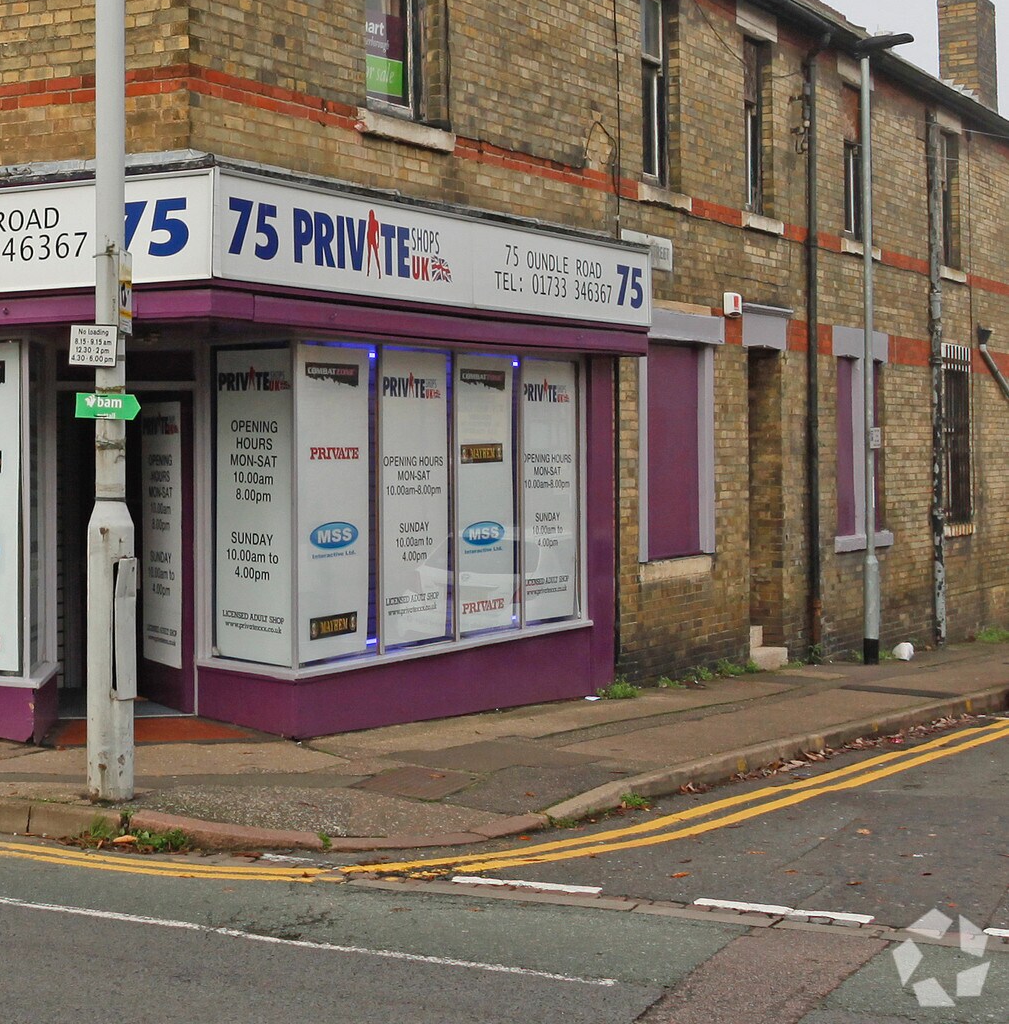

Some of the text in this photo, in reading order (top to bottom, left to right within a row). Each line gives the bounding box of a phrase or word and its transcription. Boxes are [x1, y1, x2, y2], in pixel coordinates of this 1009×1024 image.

[228, 197, 439, 282] 75 PRIVATE SHOPS UK
[505, 244, 602, 279] 75 OUNDLE ROAD
[495, 271, 612, 304] TEL: 01733 346367
[616, 264, 644, 309] 75
[219, 366, 269, 391] PRIVATE
[383, 372, 425, 398] PRIVATE
[97, 397, 122, 409] bam
[231, 420, 278, 433] OPENING
[236, 437, 273, 450] HOURS
[310, 447, 359, 459] PRIVATE
[551, 454, 571, 464] HOURS
[230, 454, 277, 468] MON-SAT
[383, 456, 444, 466] OPENING HOURS
[234, 471, 273, 485] 10.00am
[397, 470, 430, 481] MON-SAT
[533, 467, 561, 476] MON-SAT
[236, 488, 271, 504] 8.00pm
[387, 485, 441, 496] 10.00am-8.00pm
[535, 512, 560, 523] SUNDAY
[399, 522, 429, 533] SUNDAY
[469, 526, 500, 541] MSS
[557, 525, 563, 534] to
[231, 531, 273, 546] SUNDAY
[317, 527, 352, 544] MSS
[396, 536, 433, 548] 10.00am to
[226, 548, 279, 564] 10.00am to
[402, 551, 427, 562] 4.00pm
[235, 566, 270, 582] 4.00pm
[462, 598, 505, 614] PRIVATE
[222, 610, 284, 624] LICENSED ADULT SHOP
